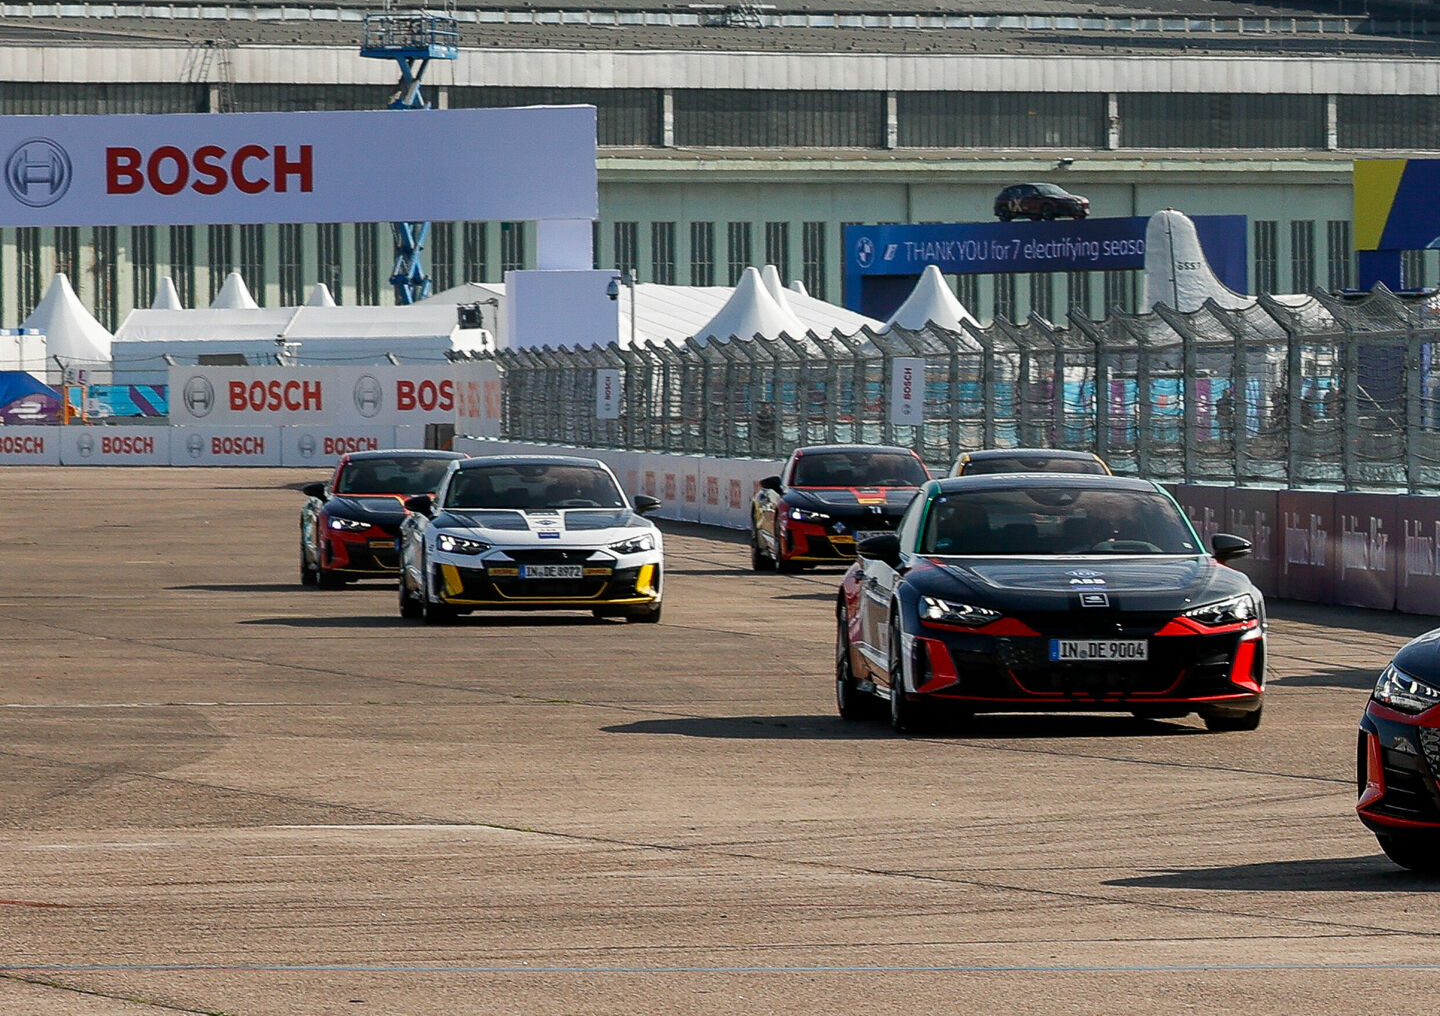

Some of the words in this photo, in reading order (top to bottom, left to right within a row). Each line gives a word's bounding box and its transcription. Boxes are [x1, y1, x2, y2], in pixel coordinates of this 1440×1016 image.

[107, 145, 312, 195] BOSCH
[904, 240, 953, 262] THANK
[955, 239, 988, 261] YOU
[991, 240, 1010, 260] for
[1012, 239, 1021, 259] 7
[1023, 237, 1099, 262] electrifying
[1103, 239, 1145, 256] seaso
[229, 380, 323, 412] BOSCH
[396, 379, 455, 411] BOS
[903, 367, 913, 400] BOSCH
[102, 437, 154, 454] BOSCH
[212, 437, 264, 454] BOSCH
[324, 437, 378, 454] BOSCH
[1060, 642, 1078, 658] IN
[1089, 642, 1107, 658] DE
[1110, 642, 1145, 658] 9004
